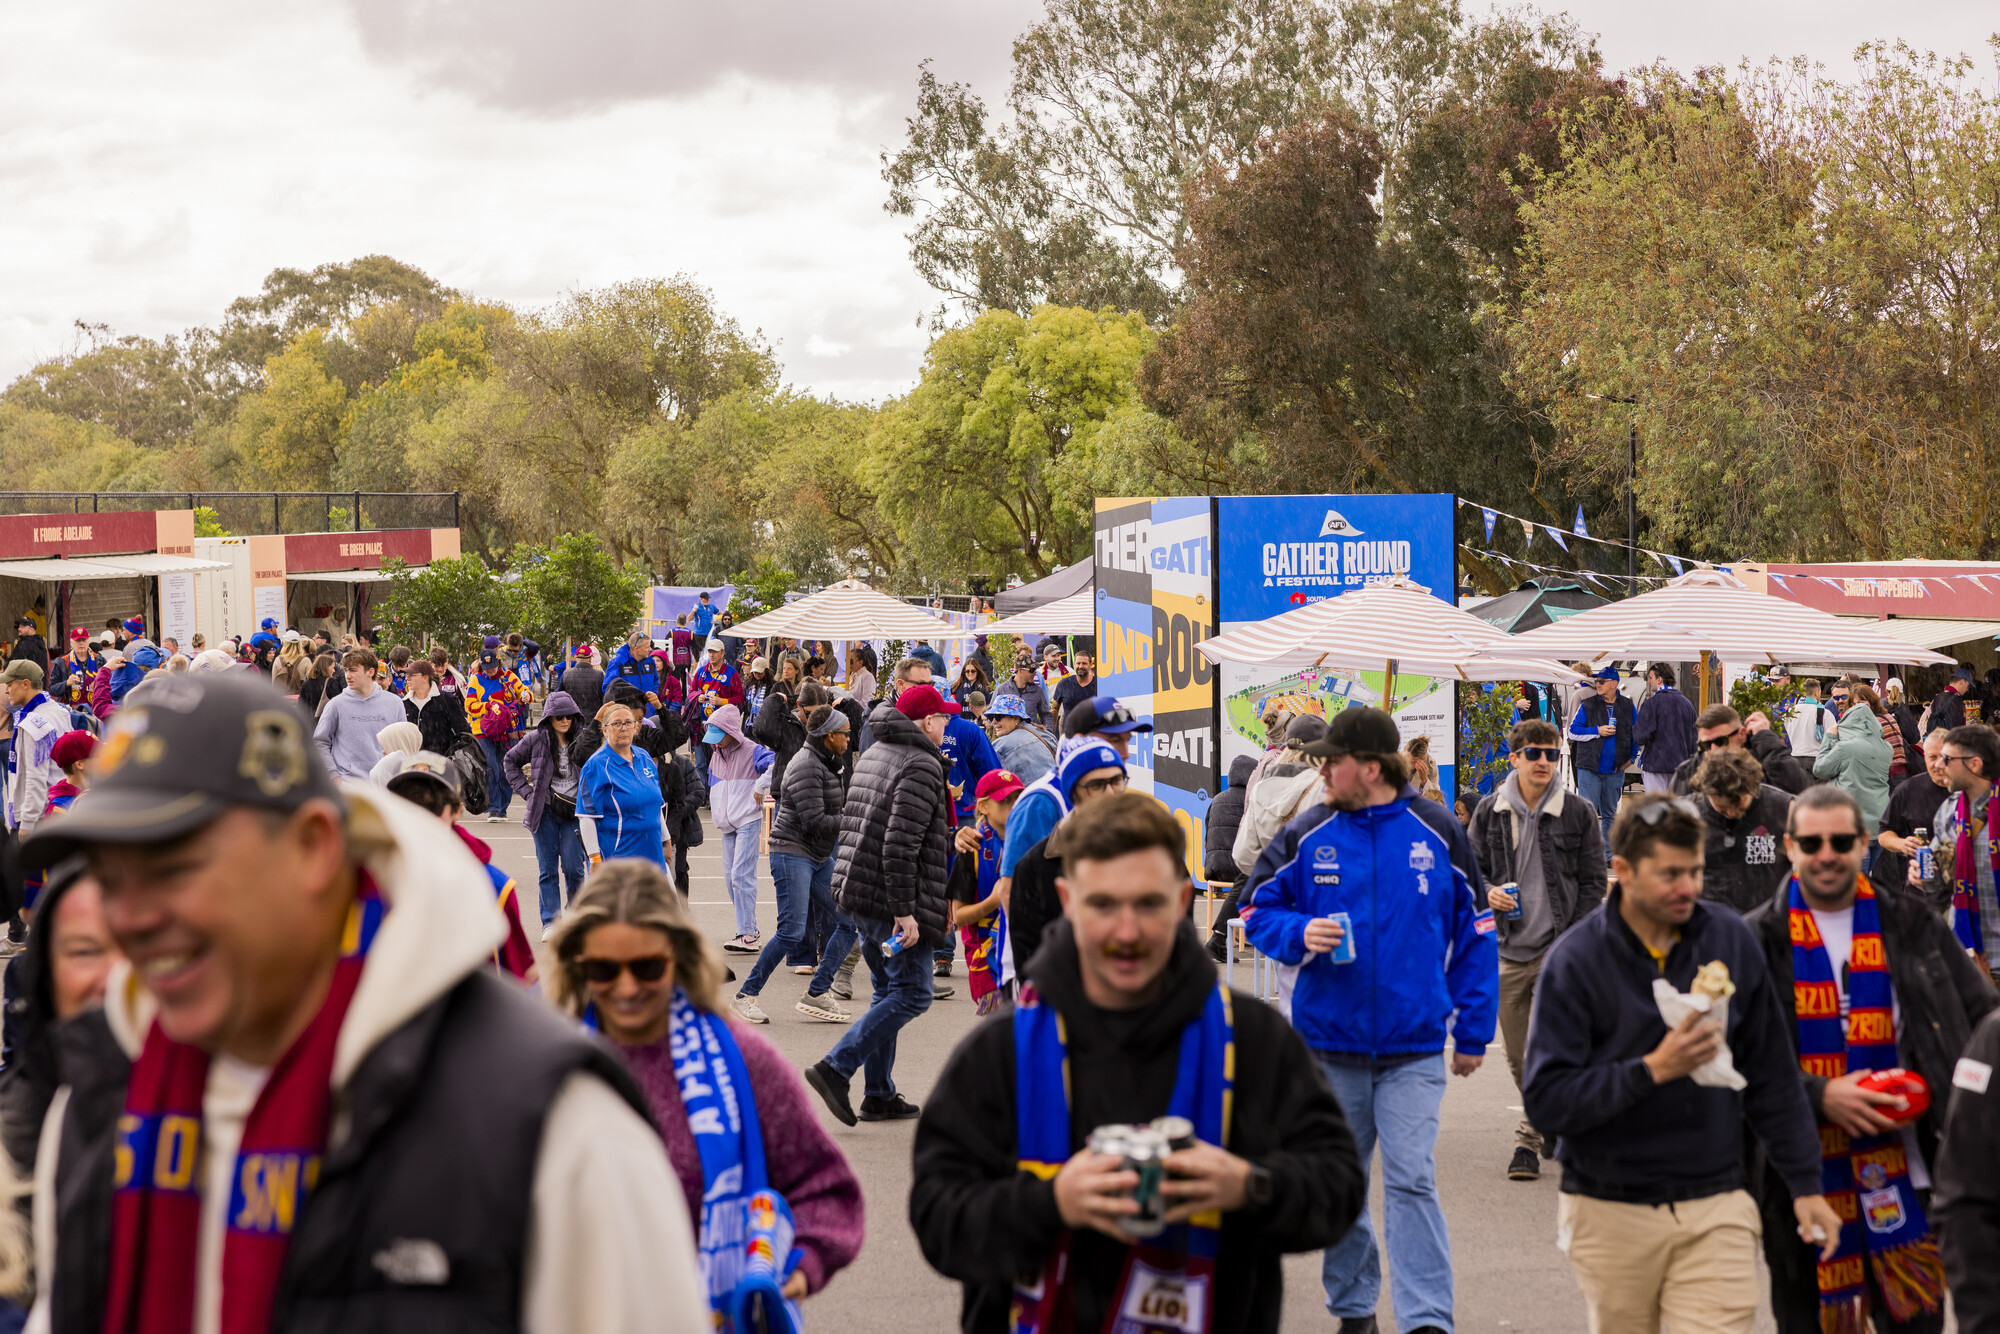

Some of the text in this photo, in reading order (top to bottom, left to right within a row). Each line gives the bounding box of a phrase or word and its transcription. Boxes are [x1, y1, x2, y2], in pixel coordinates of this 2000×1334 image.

[1330, 521, 1346, 529] AFL
[34, 526, 93, 542] K FOODIE ADELAIDE
[340, 542, 383, 556] THE GREEK PALACE
[1263, 541, 1411, 576] GATHER ROUND
[272, 570, 283, 578] PALACE
[1263, 578, 1273, 587] A
[1276, 577, 1341, 586] FESTIVAL
[1344, 576, 1363, 585] OF
[1745, 835, 1775, 845] PINK
[1746, 844, 1775, 855] PONY
[1745, 854, 1775, 864] CLUB
